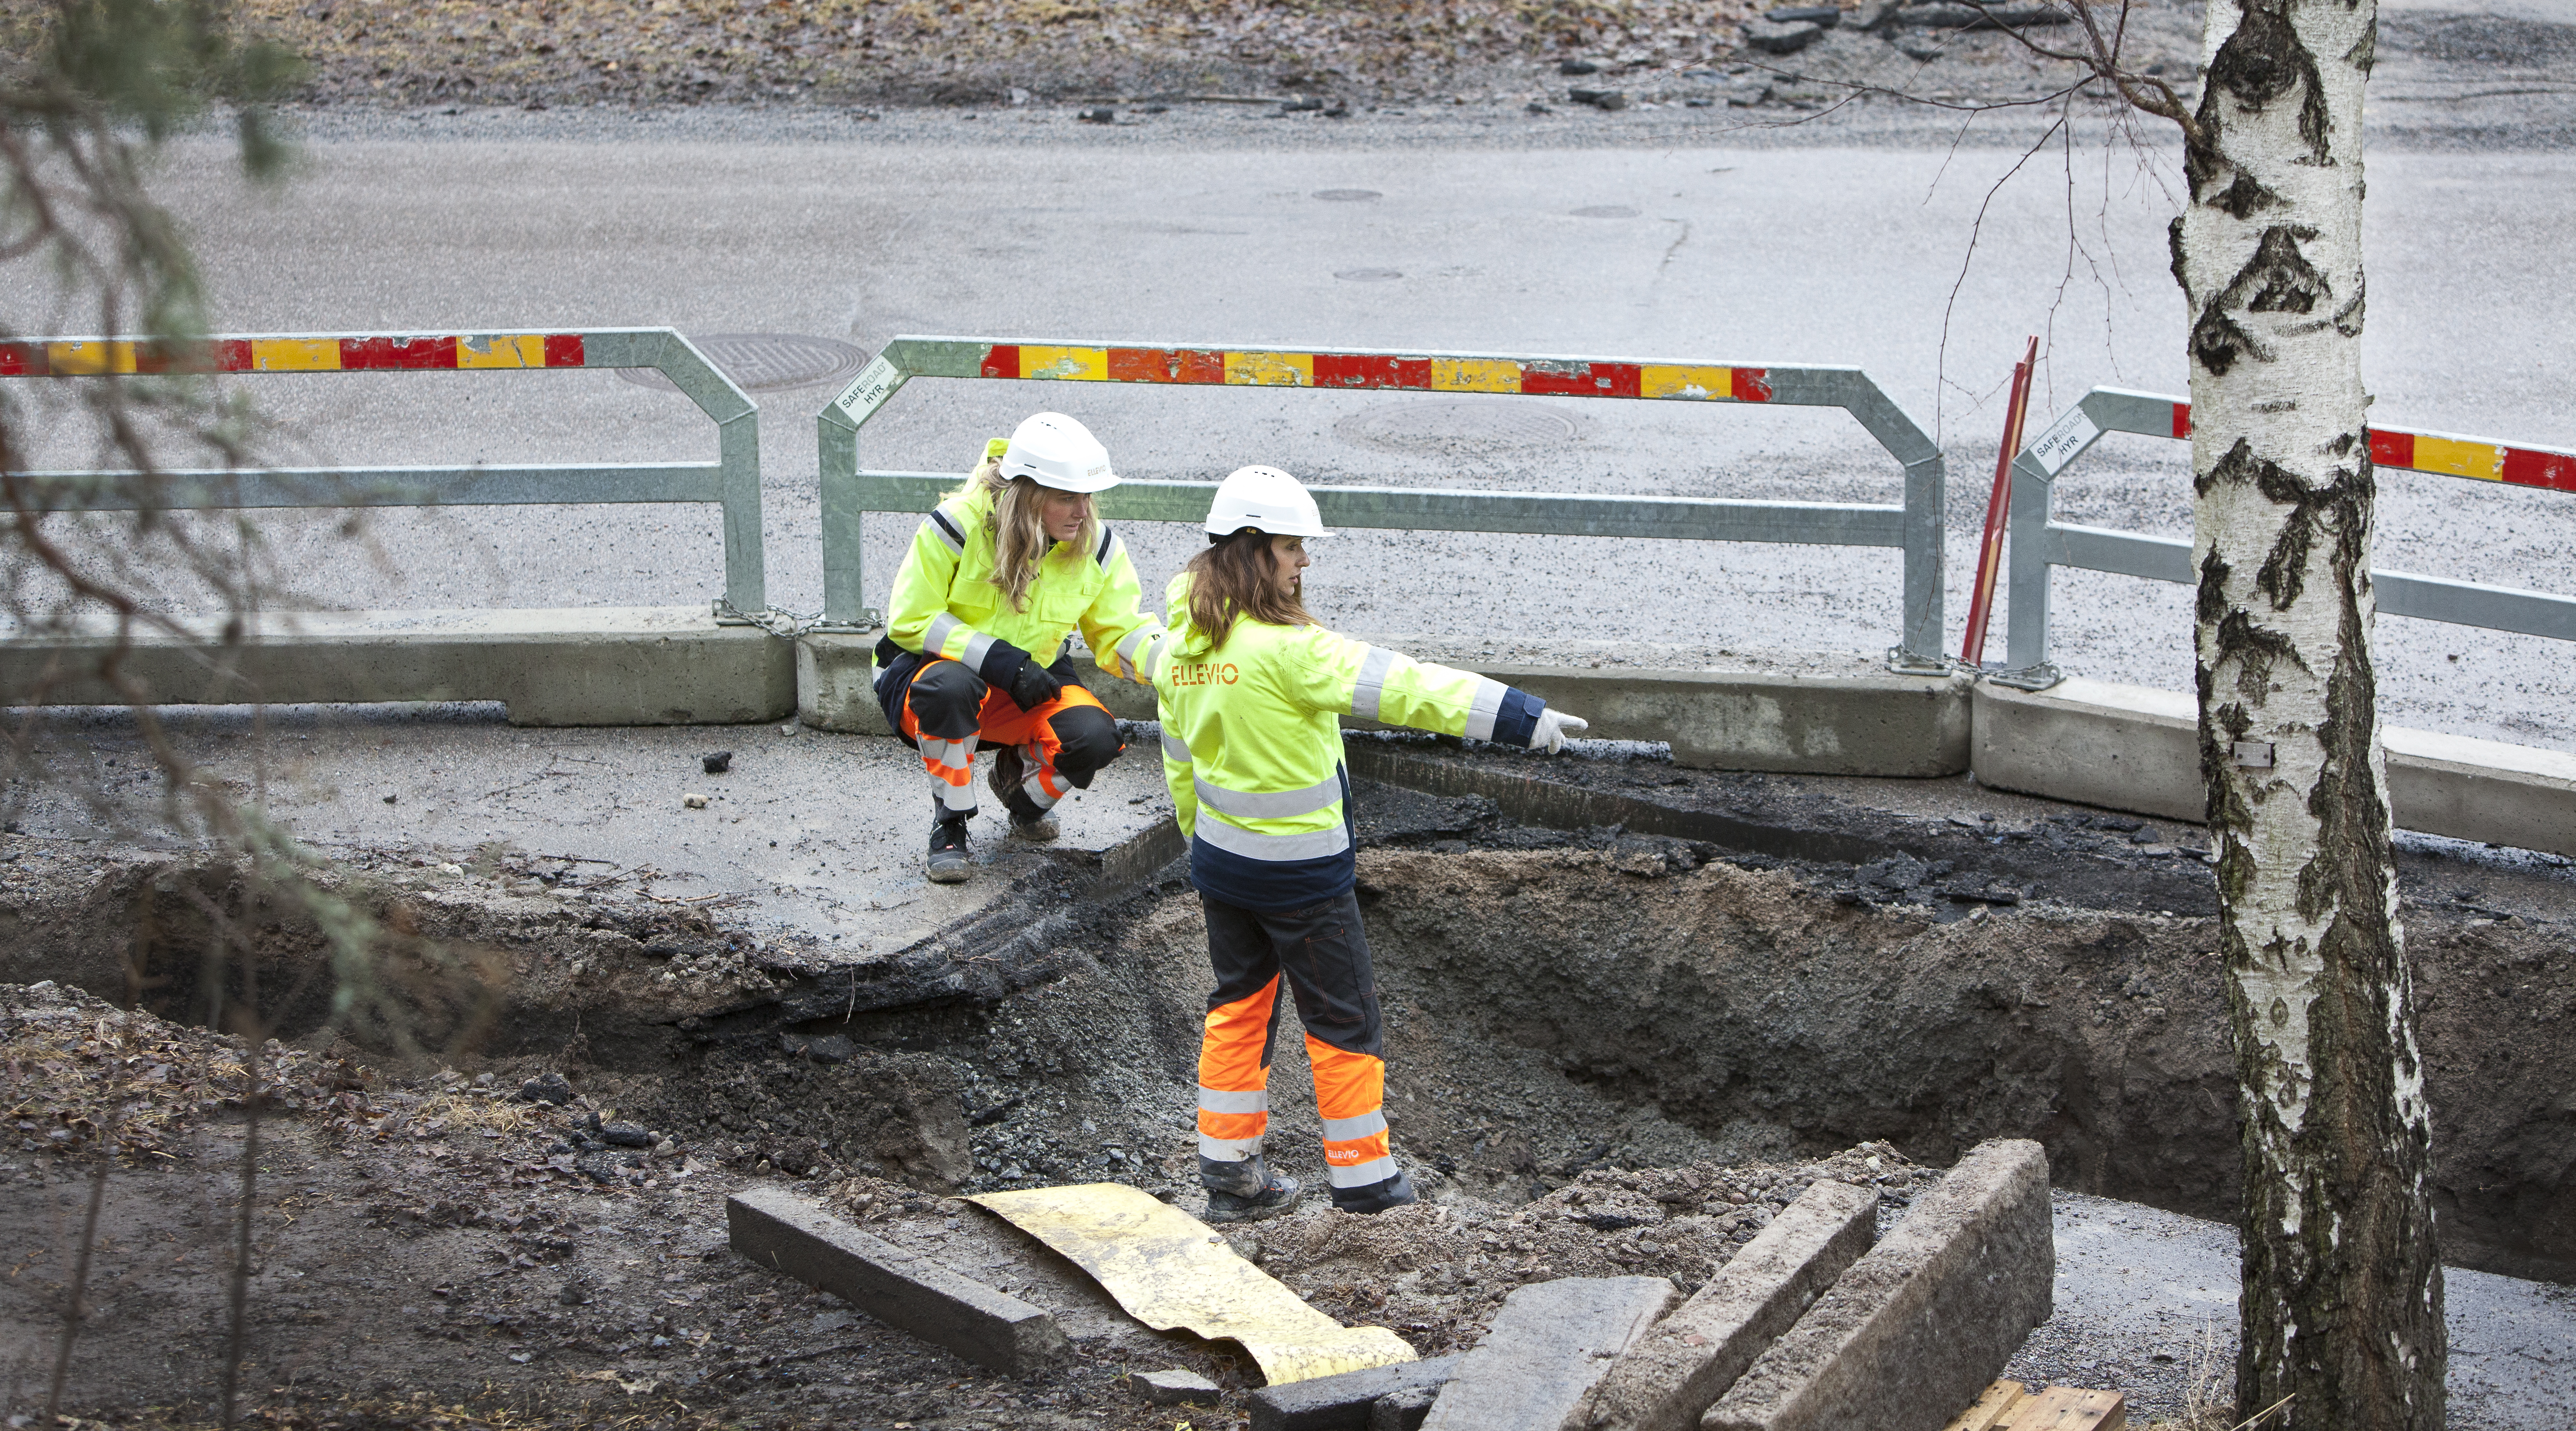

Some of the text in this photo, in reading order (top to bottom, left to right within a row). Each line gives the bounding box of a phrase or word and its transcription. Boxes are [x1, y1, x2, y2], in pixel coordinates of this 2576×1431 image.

[842, 363, 886, 408] SAFEROAD
[864, 384, 884, 404] HYR
[2059, 435, 2079, 455] HYR
[1088, 465, 1106, 477] ELLEVIO
[1171, 663, 1239, 686] ELLEVIO
[1328, 1149, 1359, 1159] ELLEVIO
